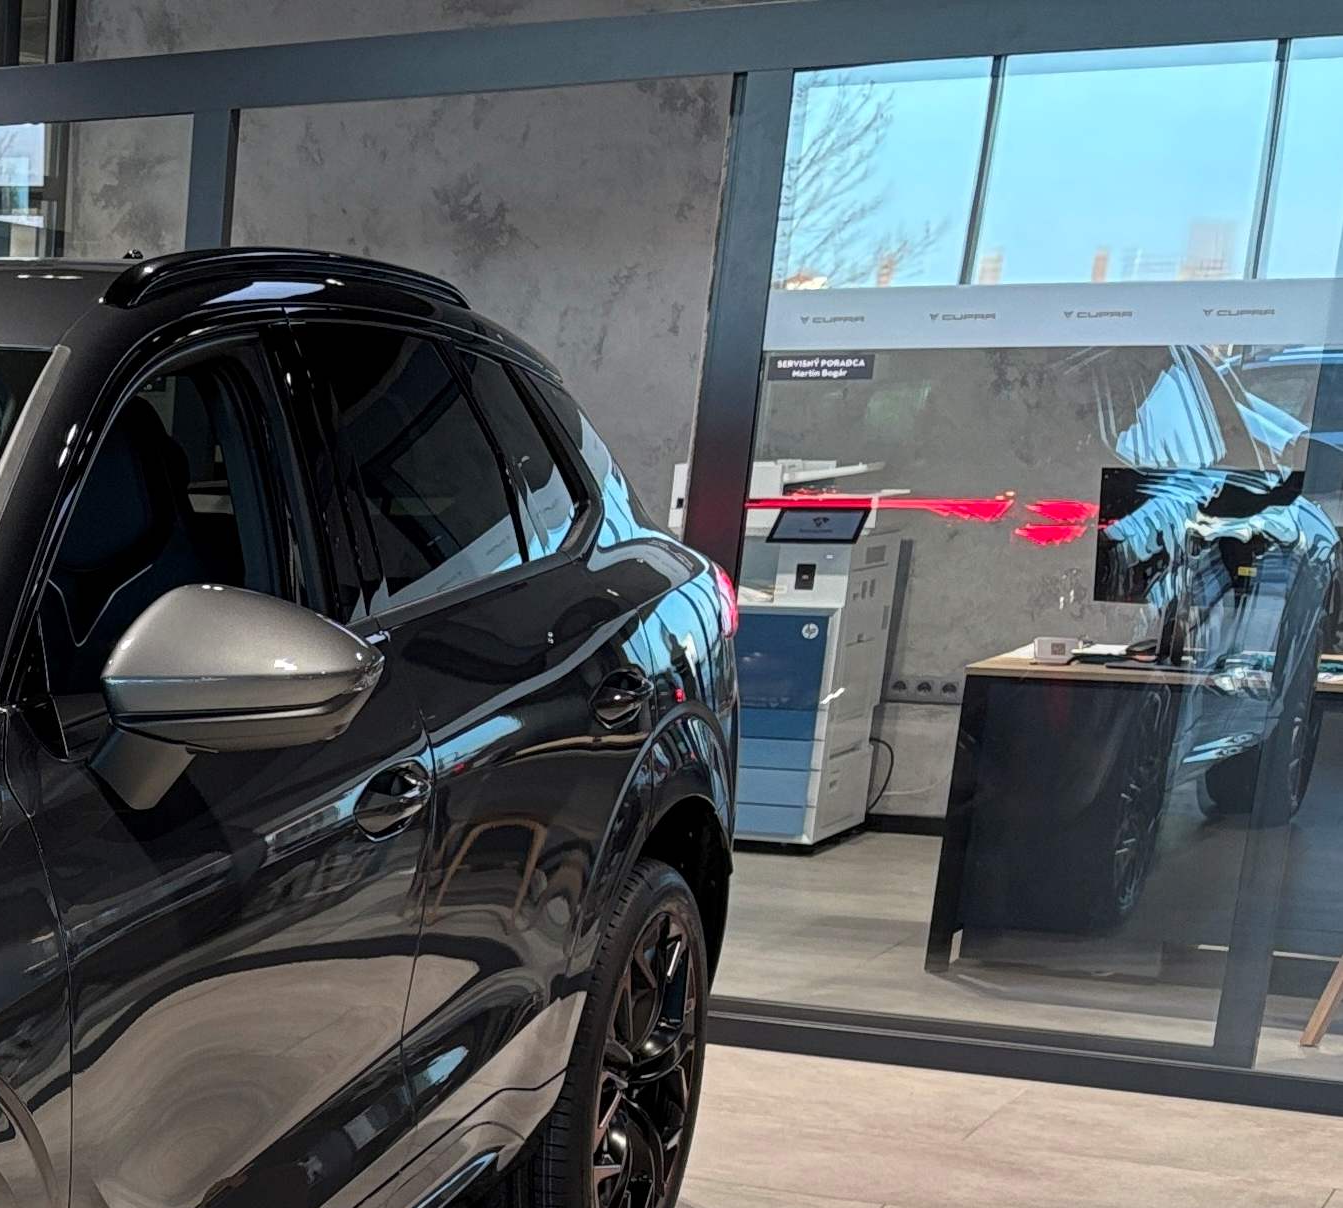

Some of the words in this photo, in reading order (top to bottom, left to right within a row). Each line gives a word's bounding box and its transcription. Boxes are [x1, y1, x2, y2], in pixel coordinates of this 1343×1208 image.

[812, 315, 865, 324] CUPRA
[942, 313, 996, 321] CUPRA
[821, 359, 865, 368] PORADCA
[792, 369, 820, 377] Martin
